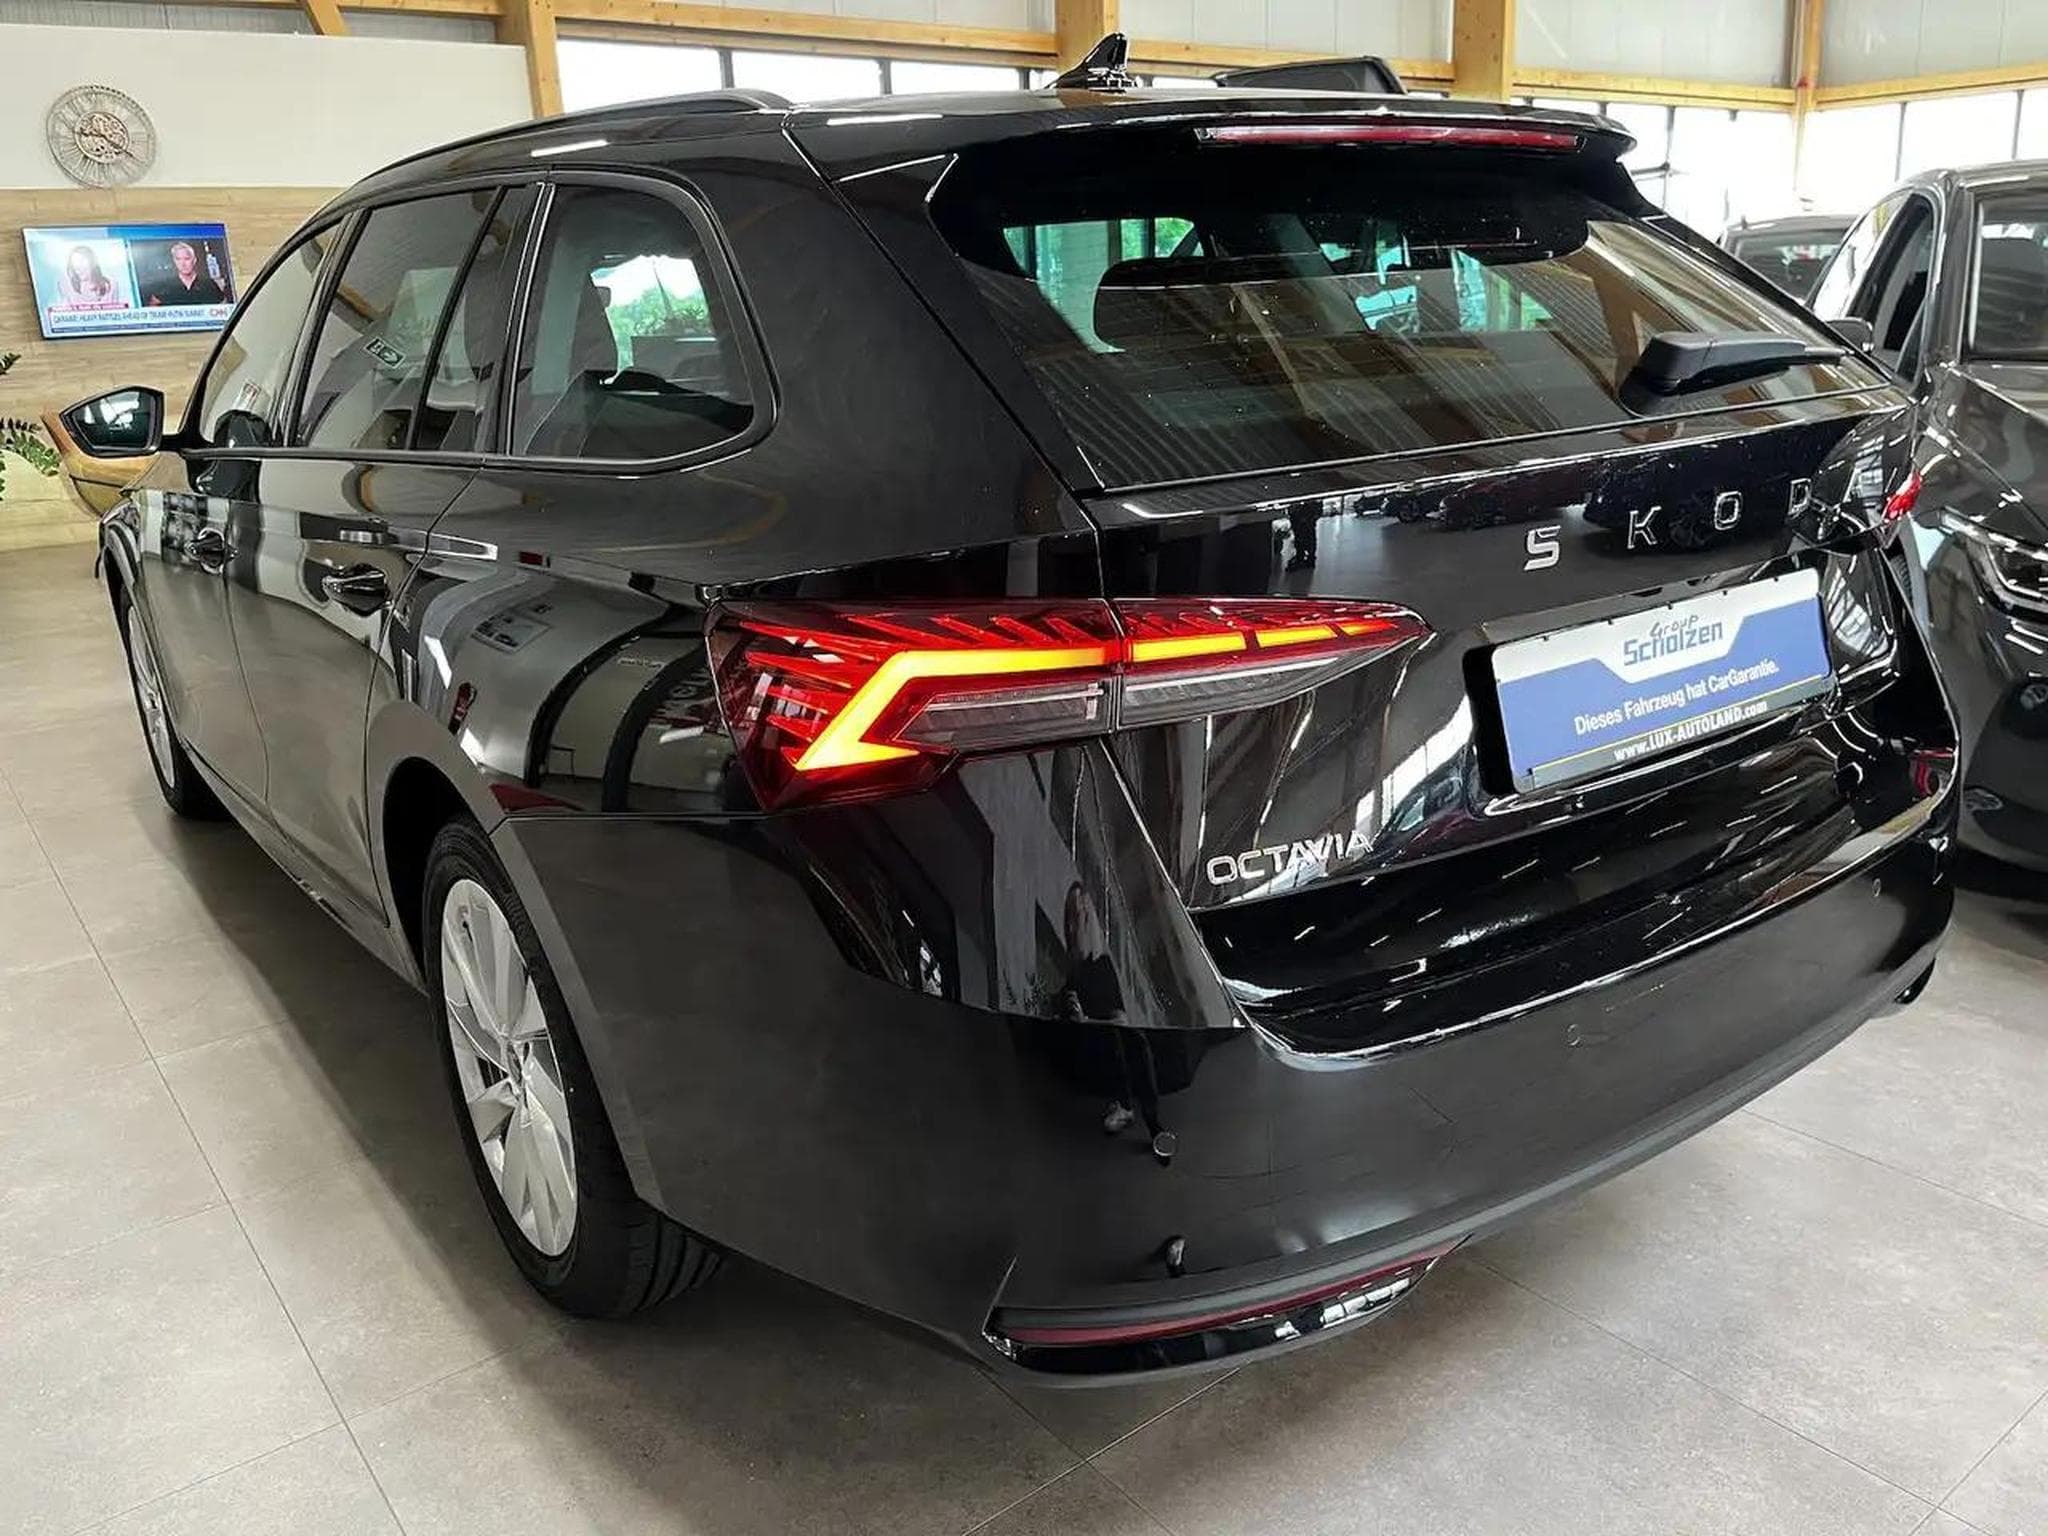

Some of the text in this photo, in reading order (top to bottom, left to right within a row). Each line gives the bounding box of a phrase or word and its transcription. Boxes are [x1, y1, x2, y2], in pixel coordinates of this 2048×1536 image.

[1523, 478, 1812, 571] SKOD
[1574, 658, 1780, 735] Dieses Fahrzeug hat CarGarantie.
[1613, 699, 1769, 762] www.LUX-AUTOLAND.com
[1206, 829, 1375, 886] OCTAVIA
